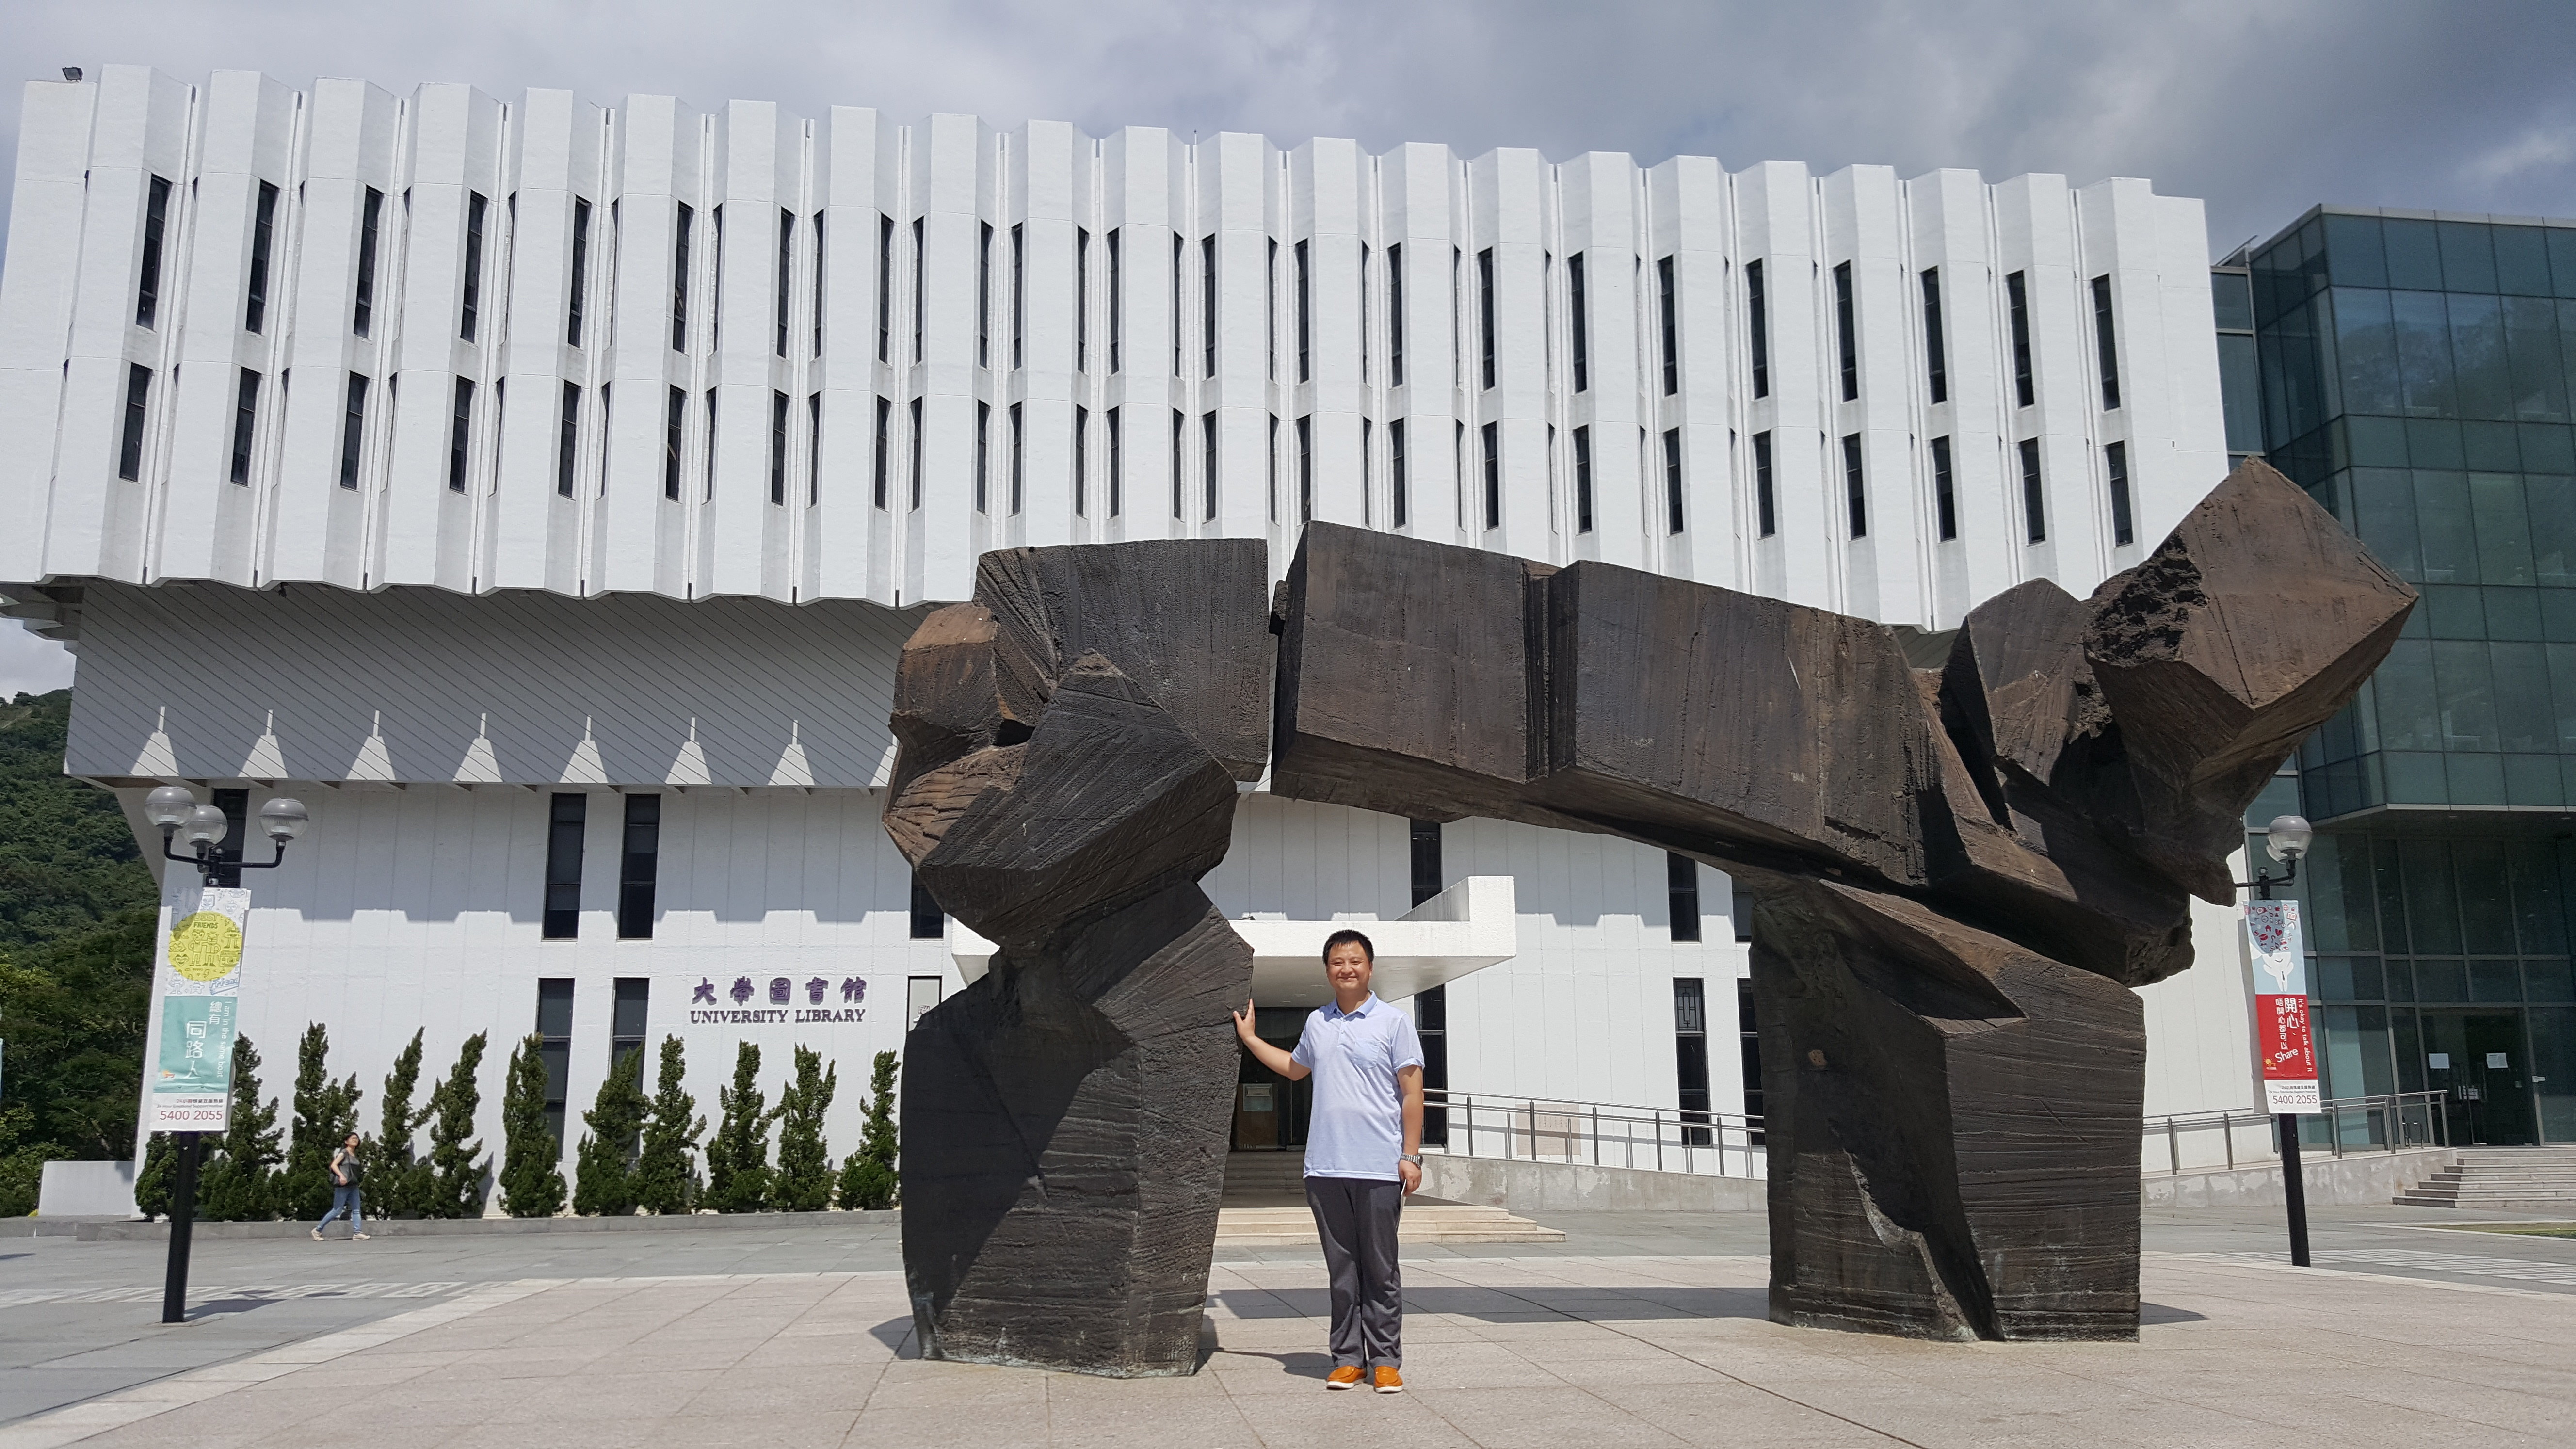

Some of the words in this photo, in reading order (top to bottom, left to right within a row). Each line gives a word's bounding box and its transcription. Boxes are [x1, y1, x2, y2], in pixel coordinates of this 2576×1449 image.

[692, 976, 867, 1006] 大學圖書館
[209, 1001, 222, 1024] 總有
[224, 1005, 230, 1016] am
[691, 1009, 788, 1024] UNIVERSITY
[795, 1009, 866, 1023] LIBRARY
[2275, 998, 2288, 1050] 唔開心都可以
[221, 1028, 229, 1039] the
[183, 1020, 207, 1079] 同路人
[218, 1041, 226, 1059] same
[2275, 1049, 2299, 1063] Share
[217, 1061, 226, 1078] boat
[2273, 1095, 2293, 1104] 5400
[2296, 1095, 2317, 1104] 2055
[160, 1111, 190, 1120] 5400
[194, 1111, 223, 1120] 2055
